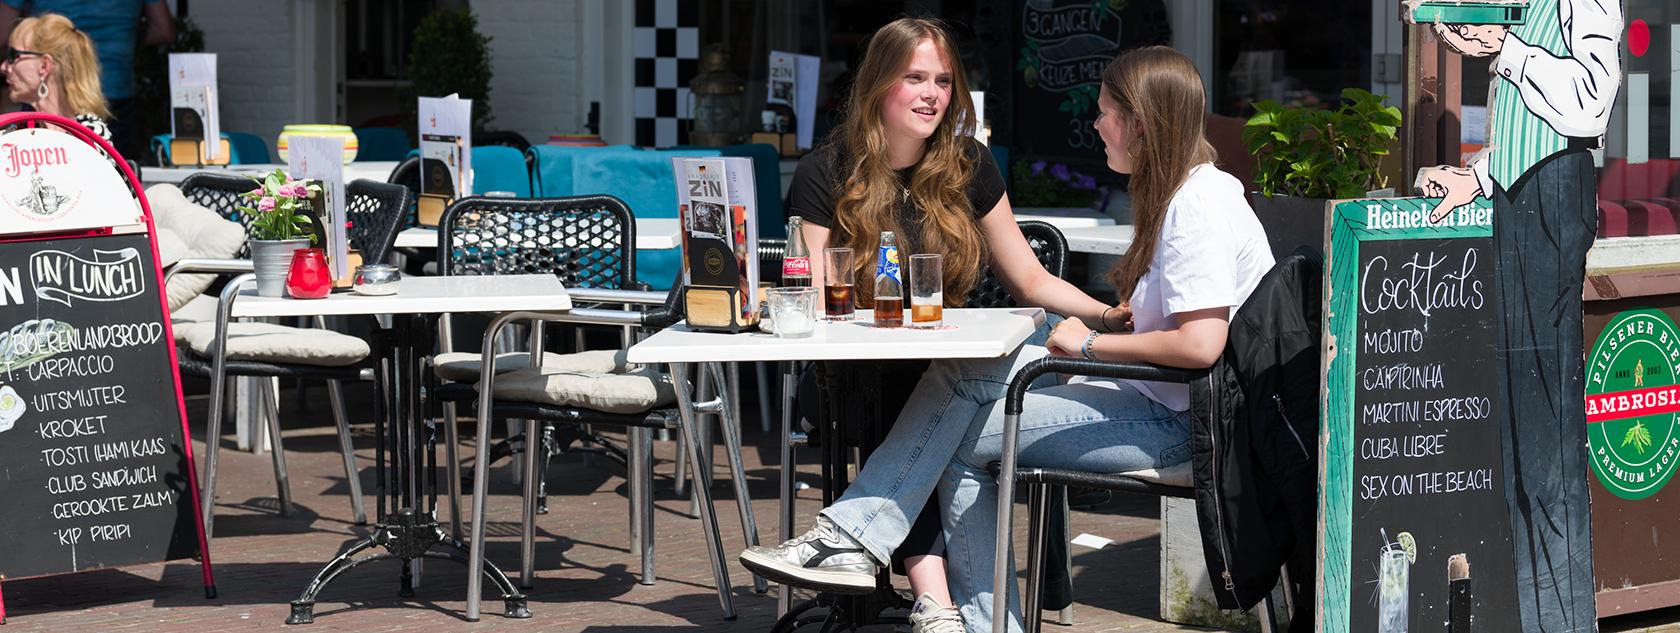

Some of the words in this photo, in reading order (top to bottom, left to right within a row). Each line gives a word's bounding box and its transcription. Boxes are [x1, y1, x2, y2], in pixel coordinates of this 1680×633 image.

[1, 143, 68, 178] Jopen
[1366, 203, 1455, 230] Heinekn
[1457, 201, 1493, 227] Bier
[36, 255, 63, 286] IN
[69, 259, 137, 297] LUNCH
[1362, 248, 1484, 316] Cocktails
[13, 322, 163, 355] BOERENLANDBROOD
[1364, 329, 1424, 354] MOJITO
[1593, 320, 1655, 385] PILSENER
[28, 355, 114, 382] CARPACCIO
[33, 385, 127, 413] UITSMIJTER
[1363, 400, 1420, 424] MARTINI
[1424, 396, 1491, 422] ESPRESSO
[1586, 389, 1680, 416] AMBROSI
[39, 415, 108, 439] KROKET
[42, 446, 90, 467] TOSTI
[1361, 437, 1400, 460] CUBA
[1403, 434, 1447, 458] LIBRE
[1598, 446, 1645, 483] PREMIUM
[1649, 437, 1679, 478] LAGER
[48, 474, 87, 495] CLUB
[91, 465, 157, 490] SANDWICH
[1361, 475, 1390, 500] SEX
[1391, 473, 1414, 496] ON
[1416, 472, 1443, 495] THE
[1445, 469, 1493, 493] BEACH
[53, 497, 129, 520] GEROOKTE
[132, 491, 172, 510] ZALM
[58, 527, 82, 546] KIP
[90, 524, 131, 542] PIRIPI
